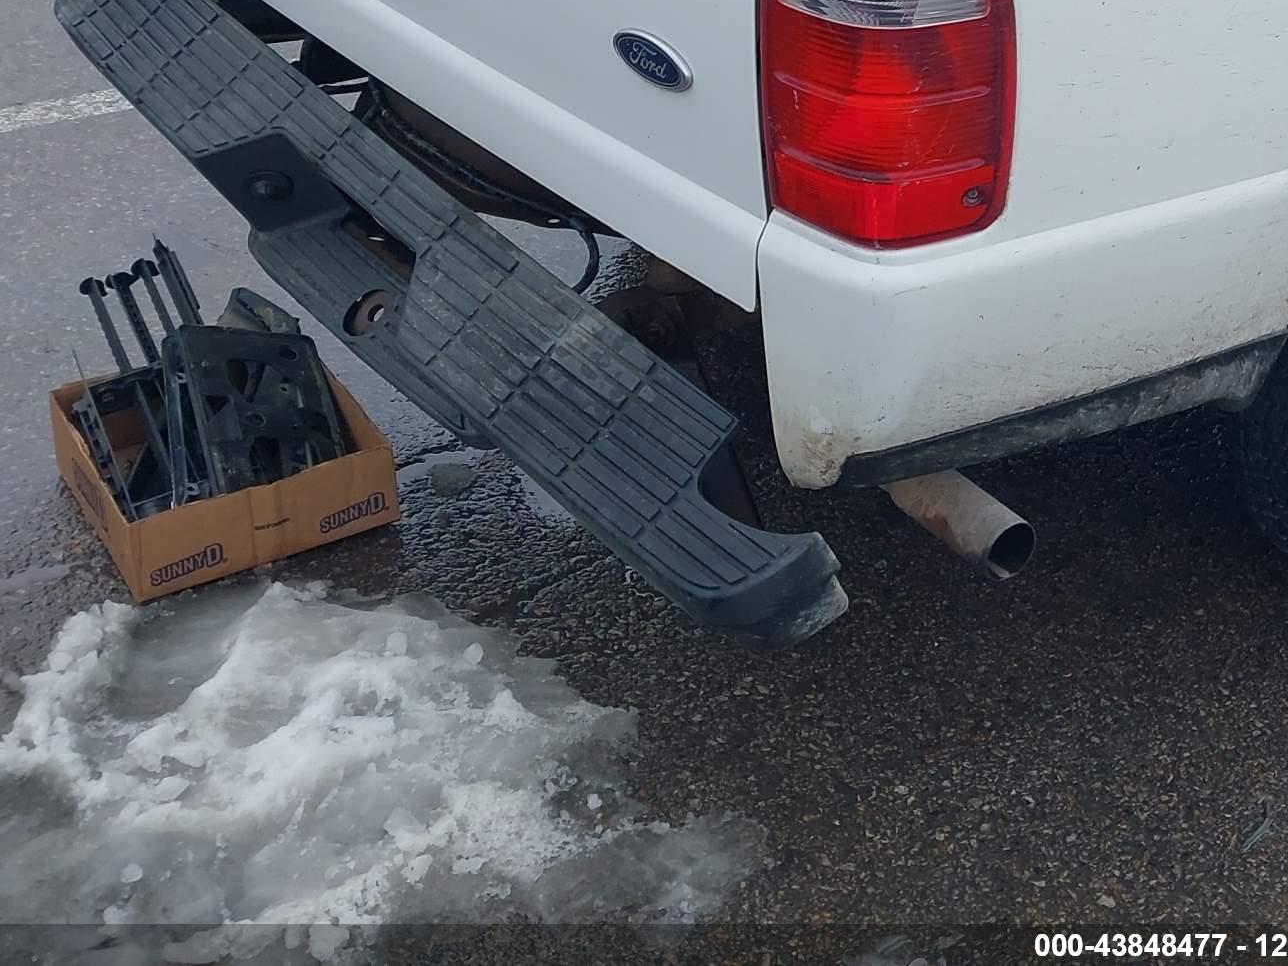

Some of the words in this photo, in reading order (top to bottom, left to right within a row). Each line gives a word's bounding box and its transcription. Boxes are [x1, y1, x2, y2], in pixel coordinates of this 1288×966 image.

[628, 41, 669, 79] Ford
[319, 491, 387, 534] SUNNYD
[150, 542, 224, 587] SUNNYD
